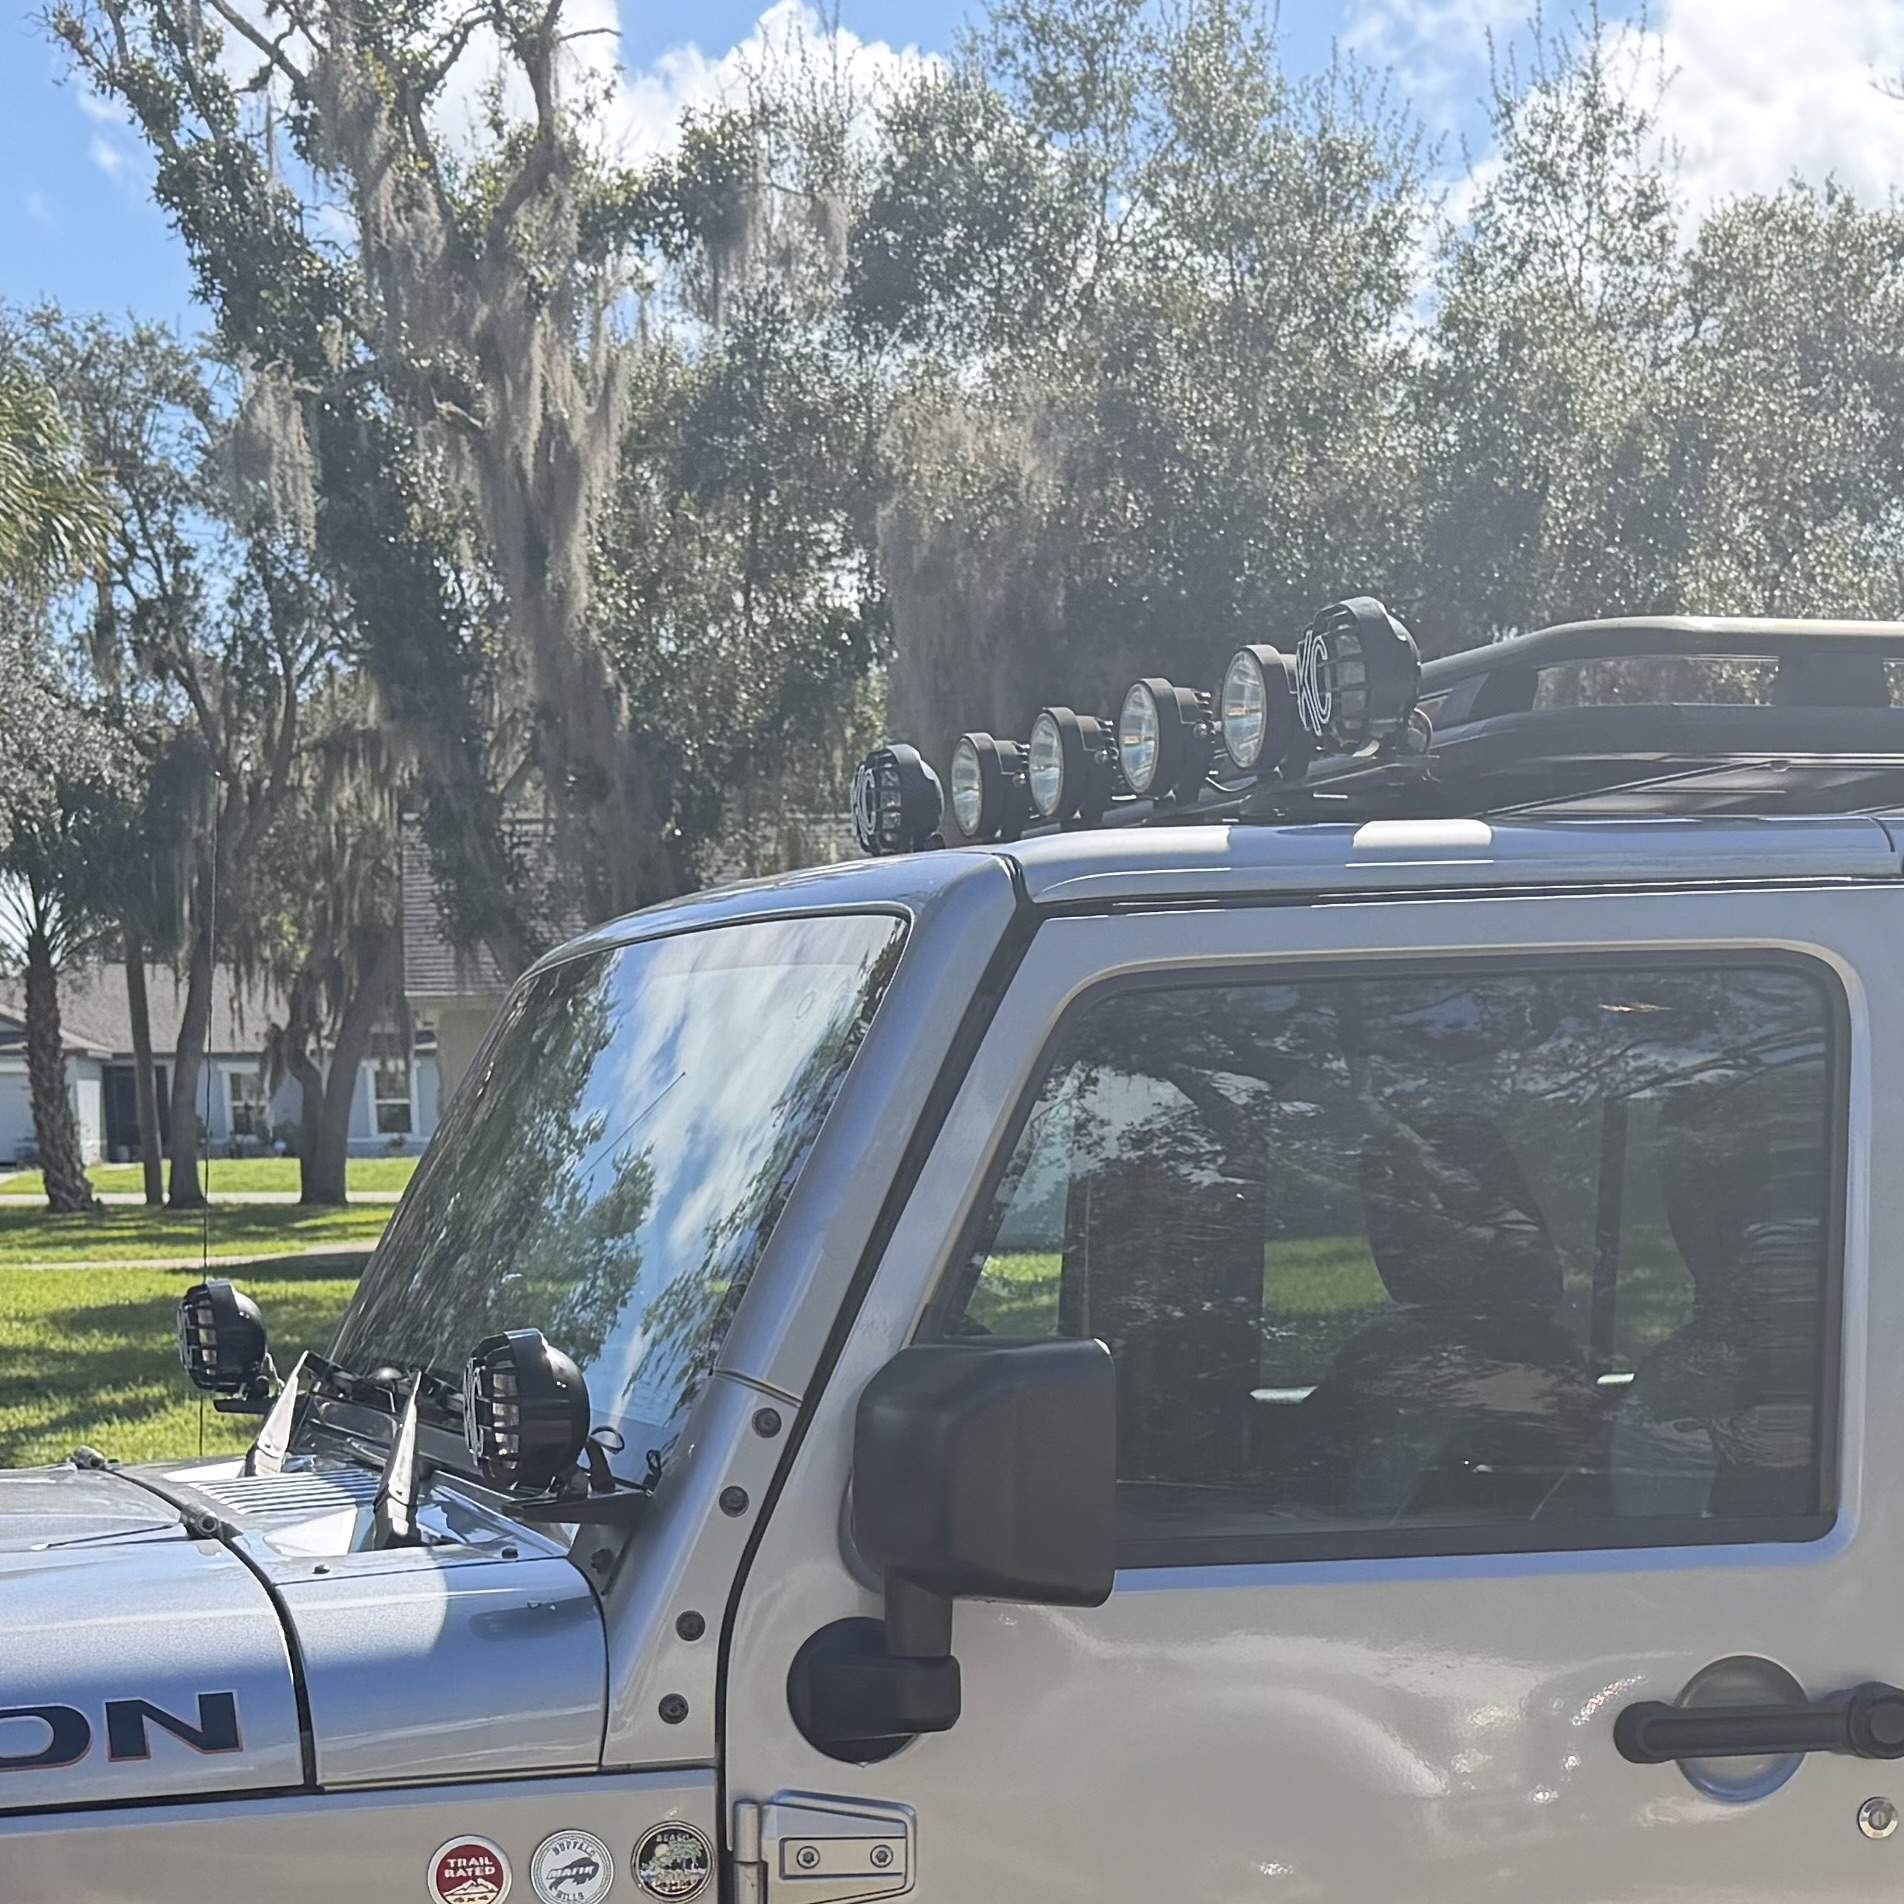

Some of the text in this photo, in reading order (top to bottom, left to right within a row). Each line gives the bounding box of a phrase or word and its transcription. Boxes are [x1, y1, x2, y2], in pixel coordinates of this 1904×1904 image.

[1296, 630, 1332, 737] KC
[446, 1856, 493, 1868] TRAIL
[443, 1866, 496, 1878] RATED
